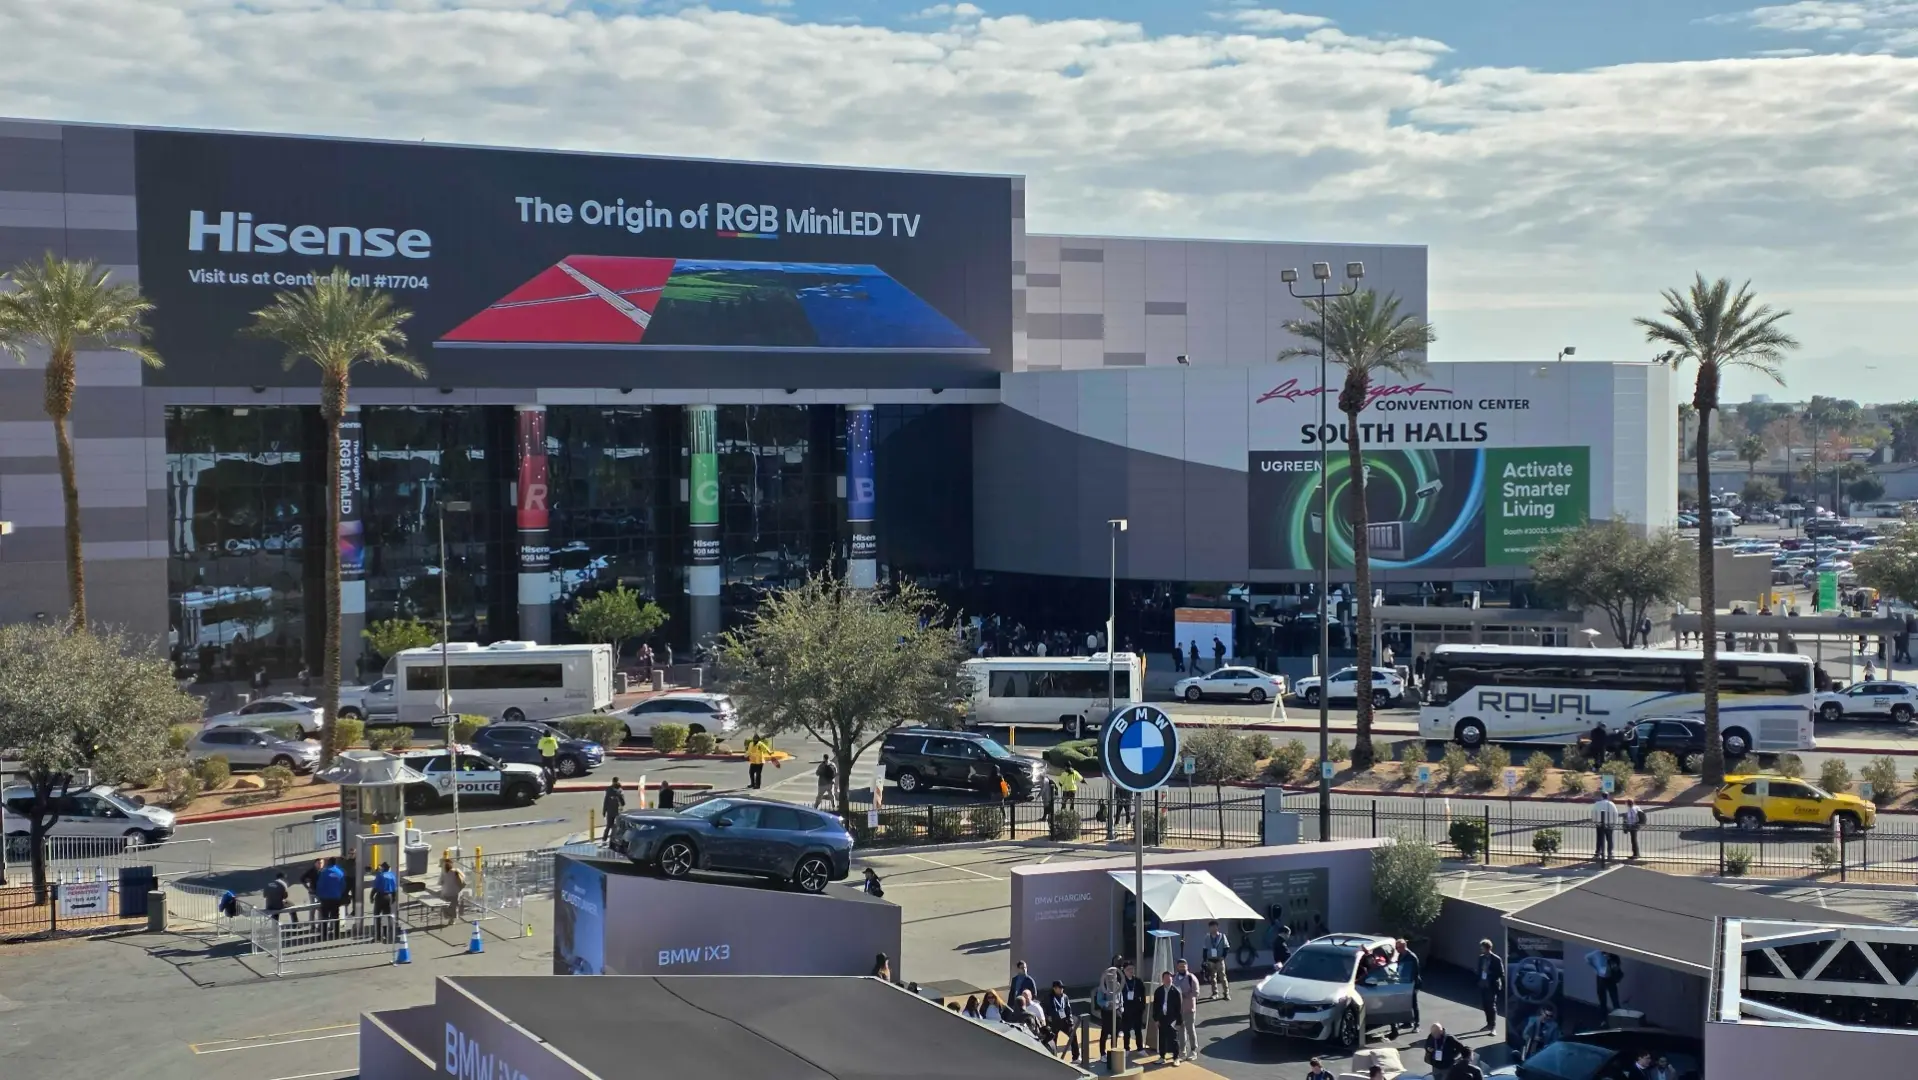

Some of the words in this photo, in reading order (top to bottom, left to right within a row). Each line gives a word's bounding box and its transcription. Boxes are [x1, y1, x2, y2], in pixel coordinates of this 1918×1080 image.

[515, 196, 573, 224] The
[580, 197, 673, 234] Origin
[679, 203, 708, 229] of
[716, 202, 779, 232] RGB
[786, 206, 883, 236] MiniLED
[887, 212, 921, 237] TV
[188, 209, 432, 259] Hisense
[188, 268, 225, 284] Visit
[229, 273, 248, 284] us
[252, 272, 270, 285] at
[372, 274, 429, 289] #17704
[1256, 378, 1338, 404] Las
[1375, 399, 1473, 411] CONVENTION
[1478, 399, 1530, 410] CENTER
[1405, 422, 1488, 443] HALLS
[339, 439, 351, 467] RGB
[352, 456, 360, 481] Origin
[1261, 460, 1323, 472] UGREEN
[1502, 461, 1573, 478] Activate
[340, 470, 352, 514] MiniLED
[524, 483, 548, 511] R
[696, 480, 719, 506] G
[855, 477, 875, 503] B
[1503, 481, 1571, 497] Smarter
[1503, 500, 1555, 519] Living
[1478, 691, 1610, 715] ROYAL
[1115, 708, 1169, 734] BMW
[457, 783, 500, 792] POLICE
[658, 947, 701, 966] BMW
[704, 944, 730, 961] iX3
